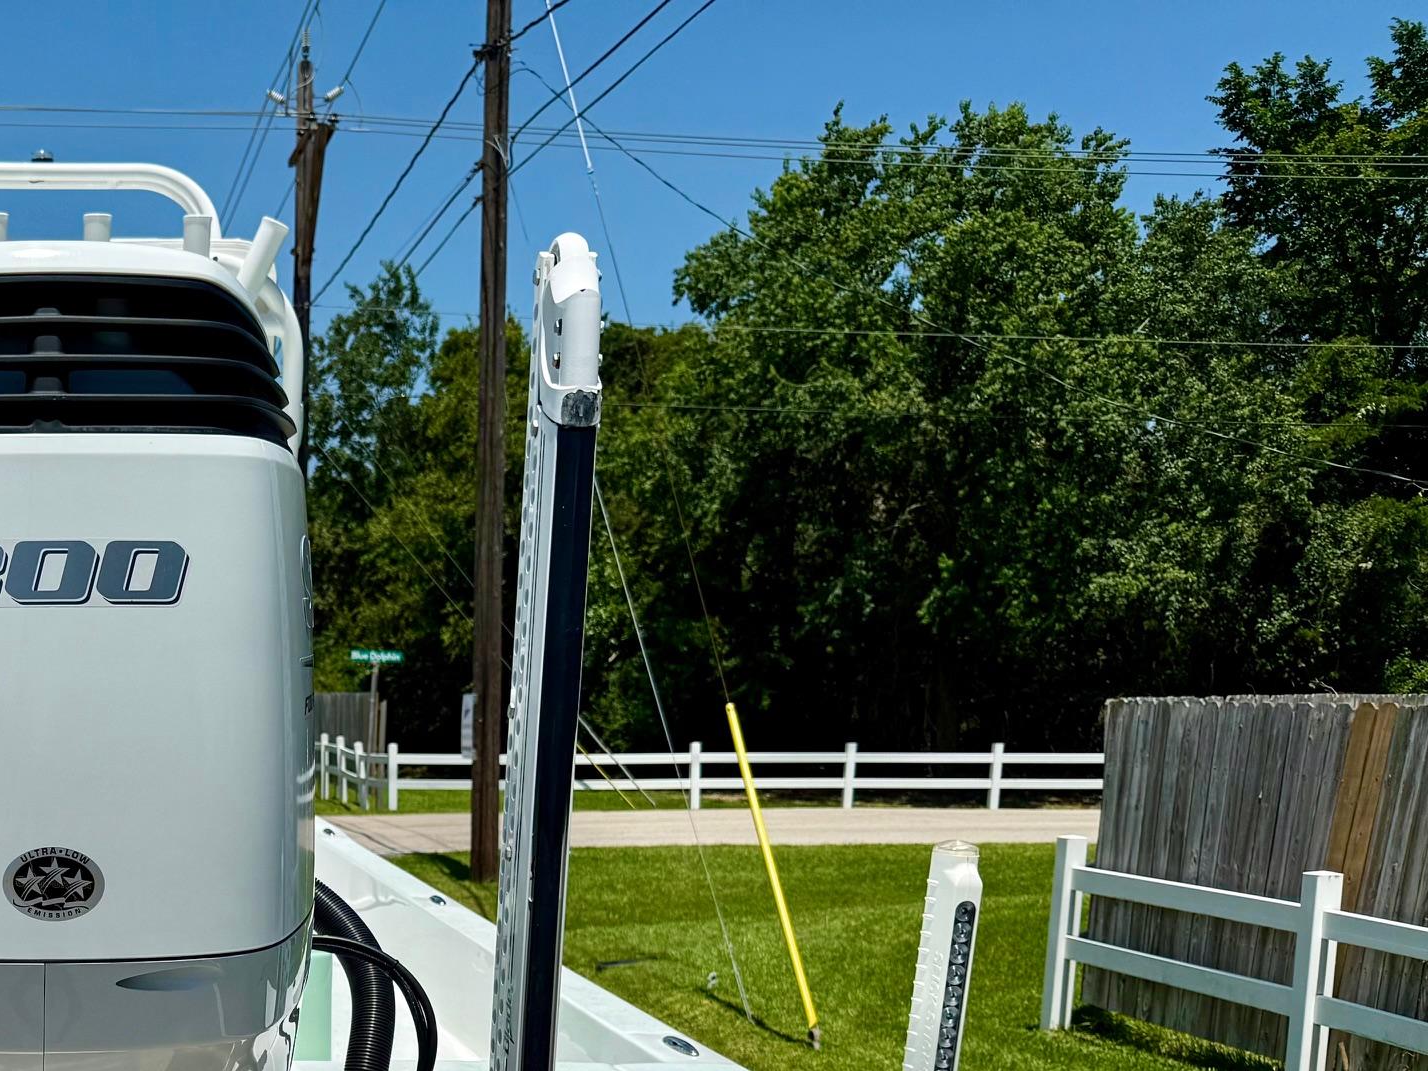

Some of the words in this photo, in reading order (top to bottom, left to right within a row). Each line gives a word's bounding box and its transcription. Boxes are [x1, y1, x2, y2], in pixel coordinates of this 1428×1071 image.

[351, 650, 369, 660] Blue
[369, 650, 401, 662] Dolphin
[27, 907, 81, 919] EMISSION
